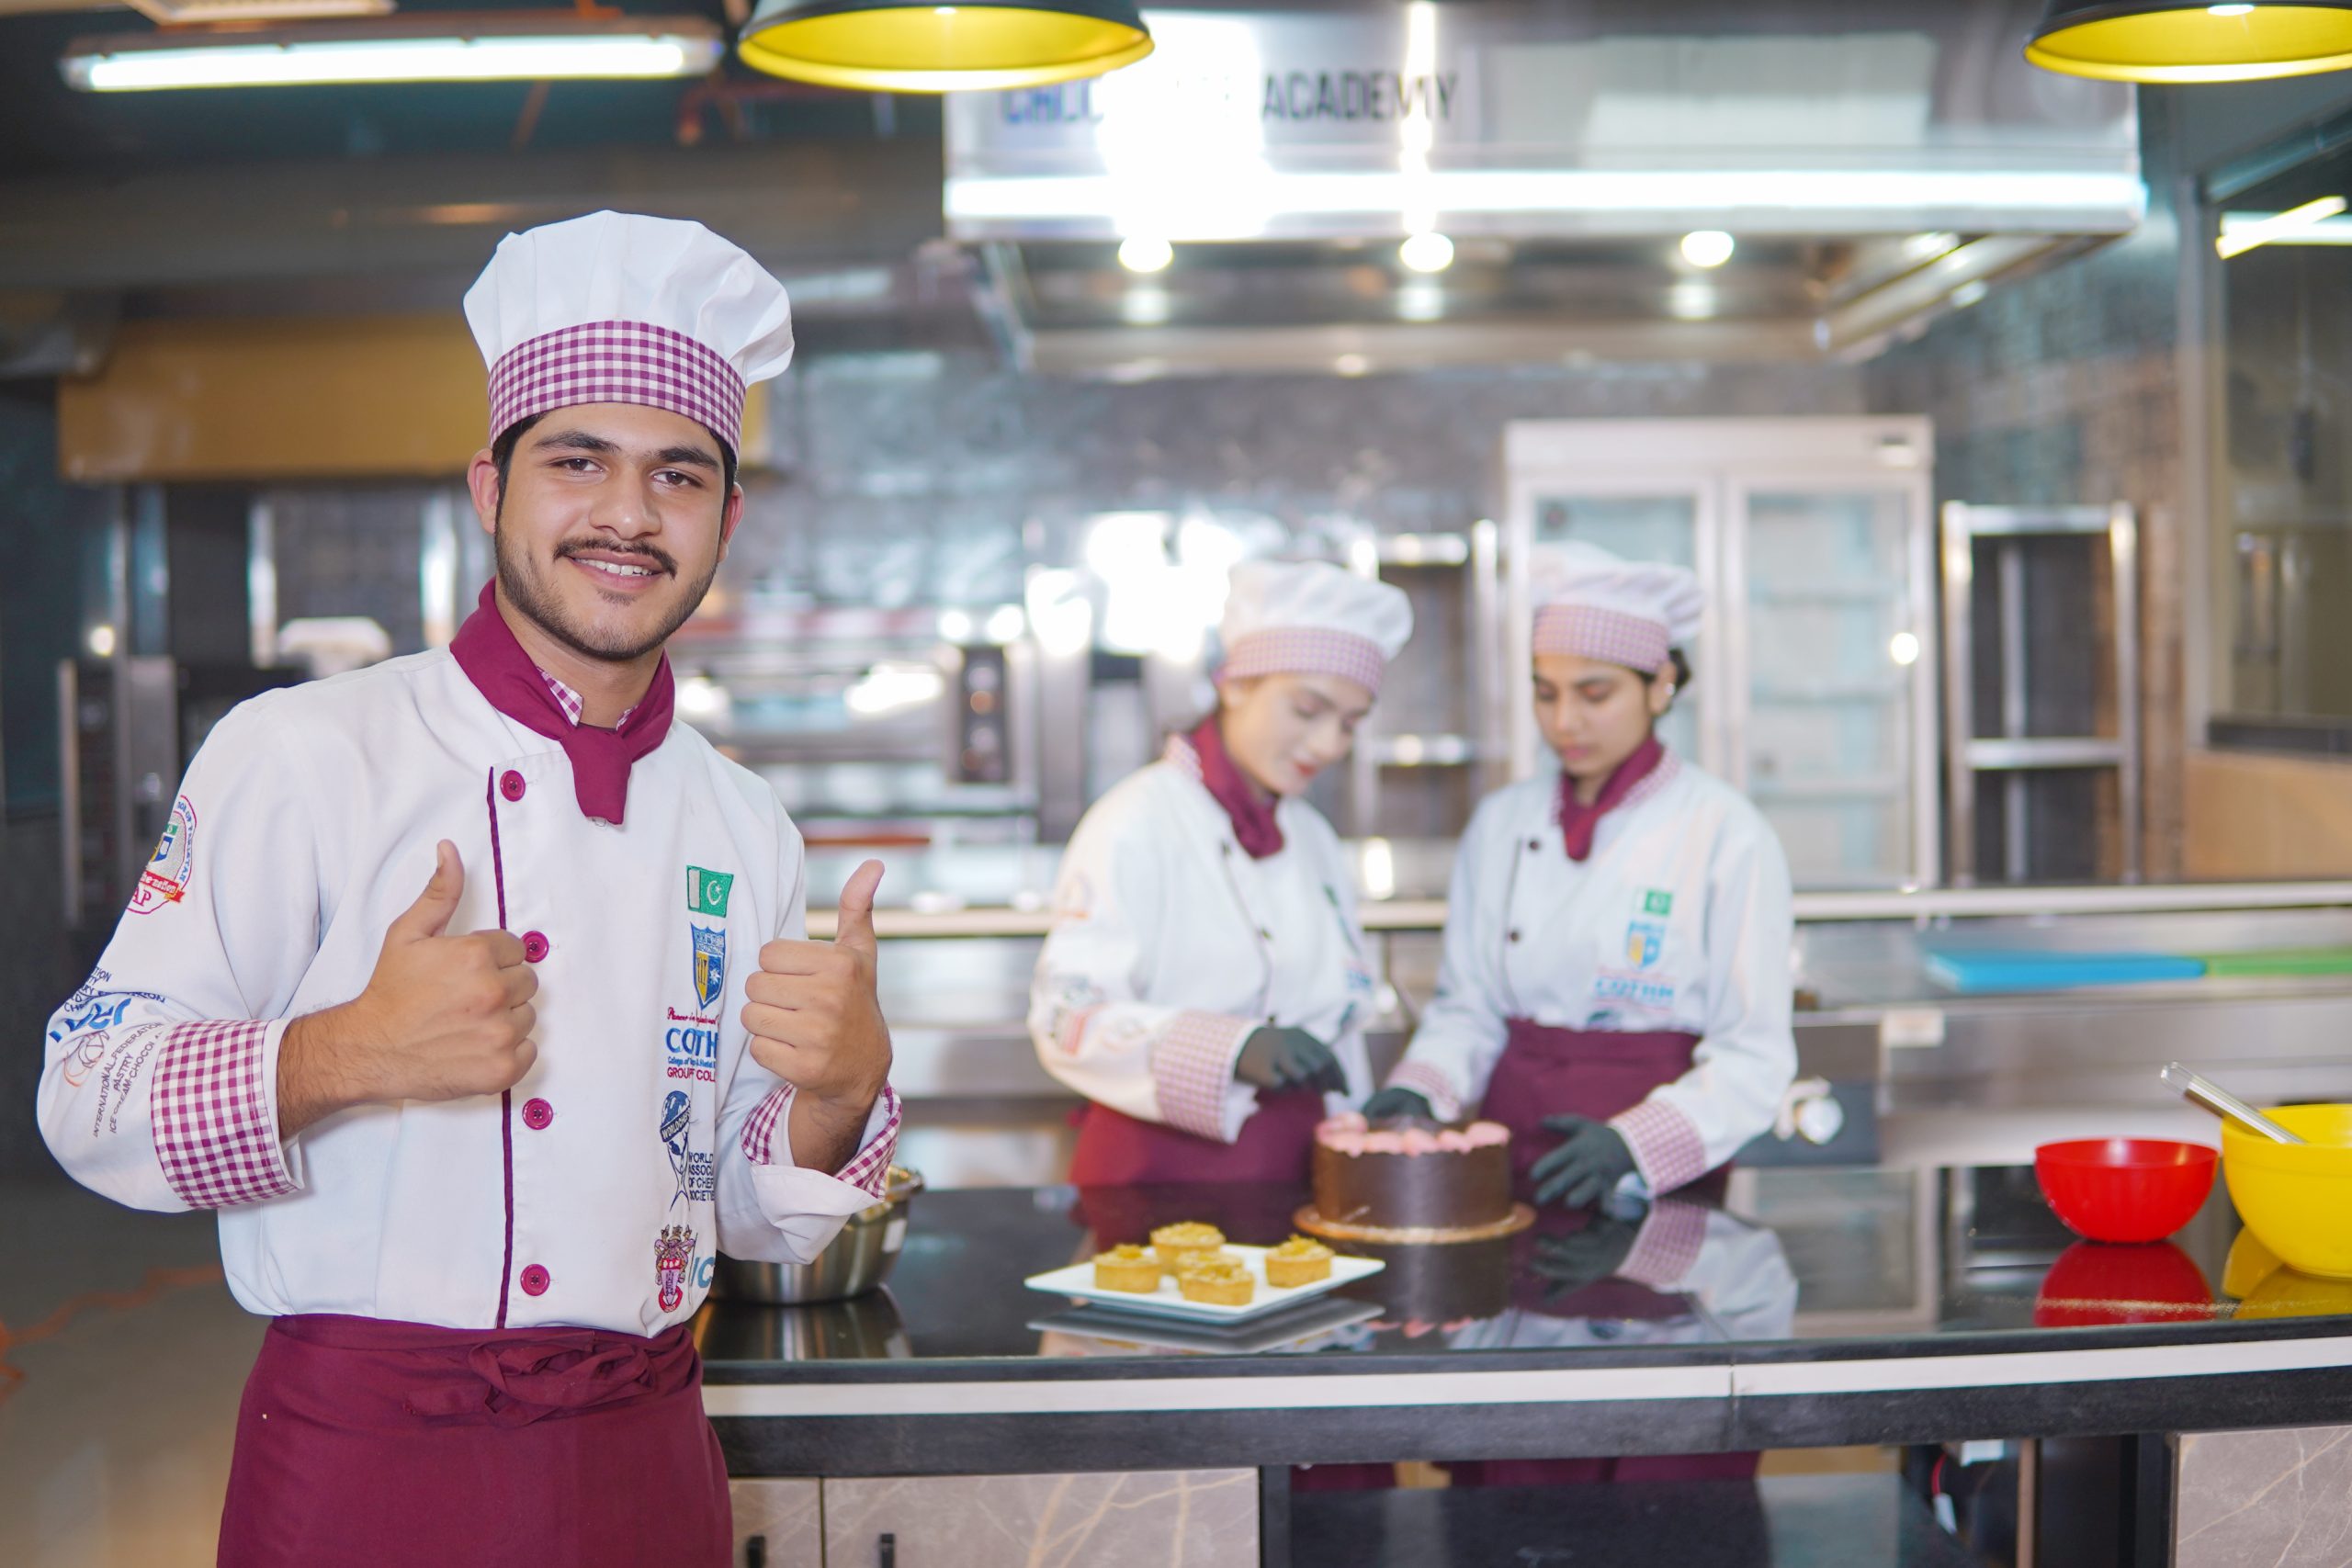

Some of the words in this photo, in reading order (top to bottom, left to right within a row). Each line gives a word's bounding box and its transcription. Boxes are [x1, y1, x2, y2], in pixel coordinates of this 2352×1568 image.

[1260, 70, 1459, 121] ACADEMY
[113, 1052, 134, 1092] PASTRY
[93, 1060, 116, 1138] INTERNATIONAL
[109, 1117, 118, 1134] ICE
